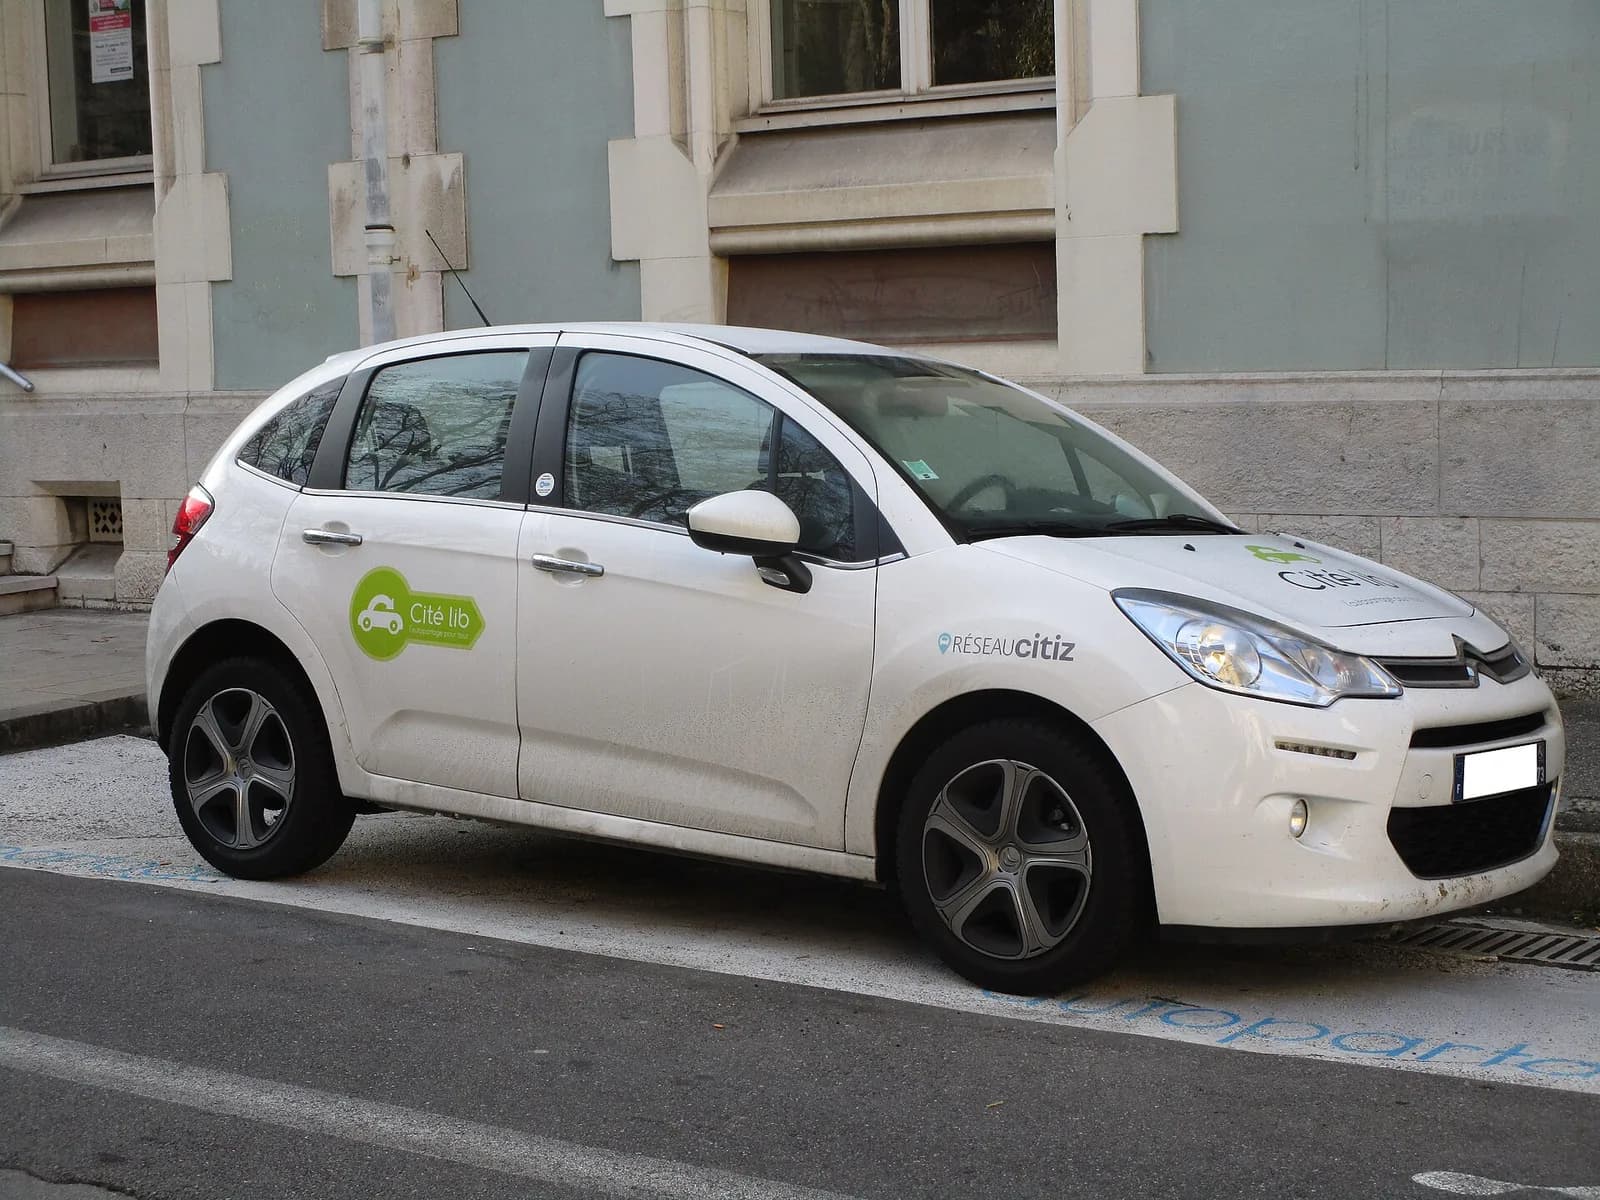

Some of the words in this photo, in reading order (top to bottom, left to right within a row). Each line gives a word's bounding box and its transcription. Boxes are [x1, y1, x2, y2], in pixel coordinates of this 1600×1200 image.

[1278, 568, 1361, 591] Cité
[410, 602, 444, 625] Cité
[448, 606, 470, 628] lib
